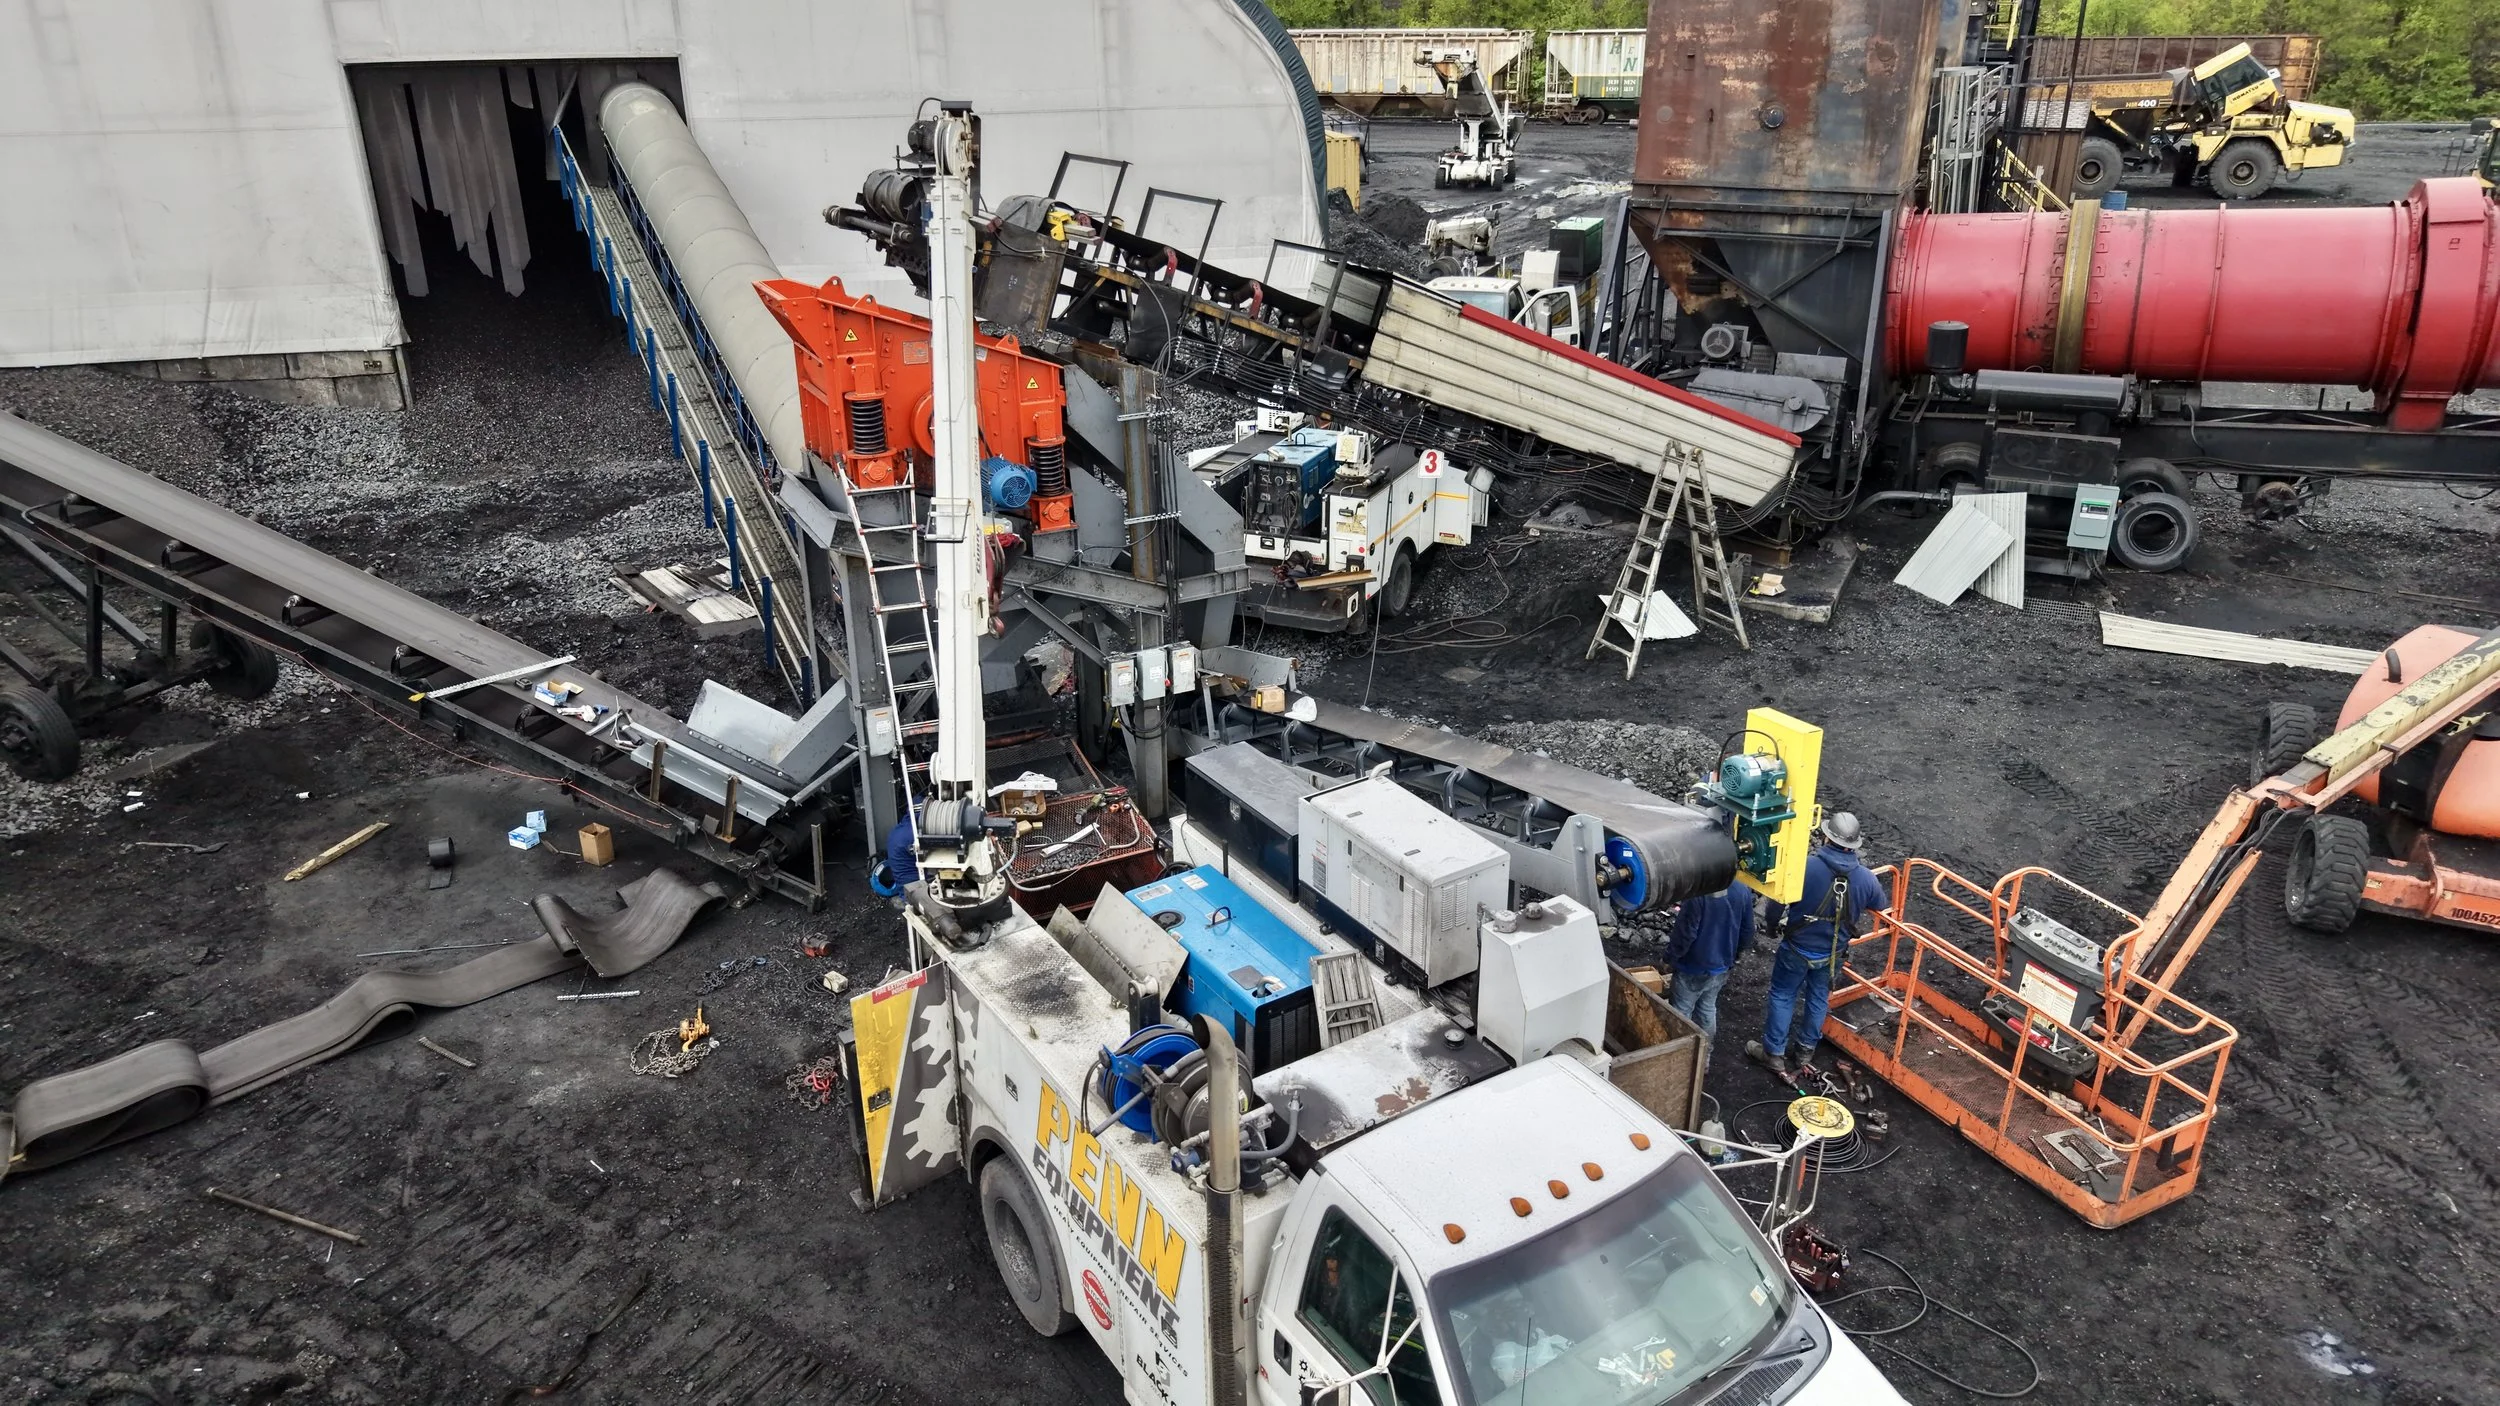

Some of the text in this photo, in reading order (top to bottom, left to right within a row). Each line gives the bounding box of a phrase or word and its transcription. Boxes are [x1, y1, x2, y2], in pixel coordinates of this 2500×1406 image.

[2231, 85, 2259, 102] KOMATSU
[1424, 451, 1438, 474] 3
[1036, 1077, 1187, 1305] PENN
[1053, 1204, 1075, 1234] HEAVY
[1075, 1235, 1118, 1287] EQUIPMENT
[1119, 1289, 1148, 1325] REPAIR
[1136, 1353, 1169, 1403] BLACK
